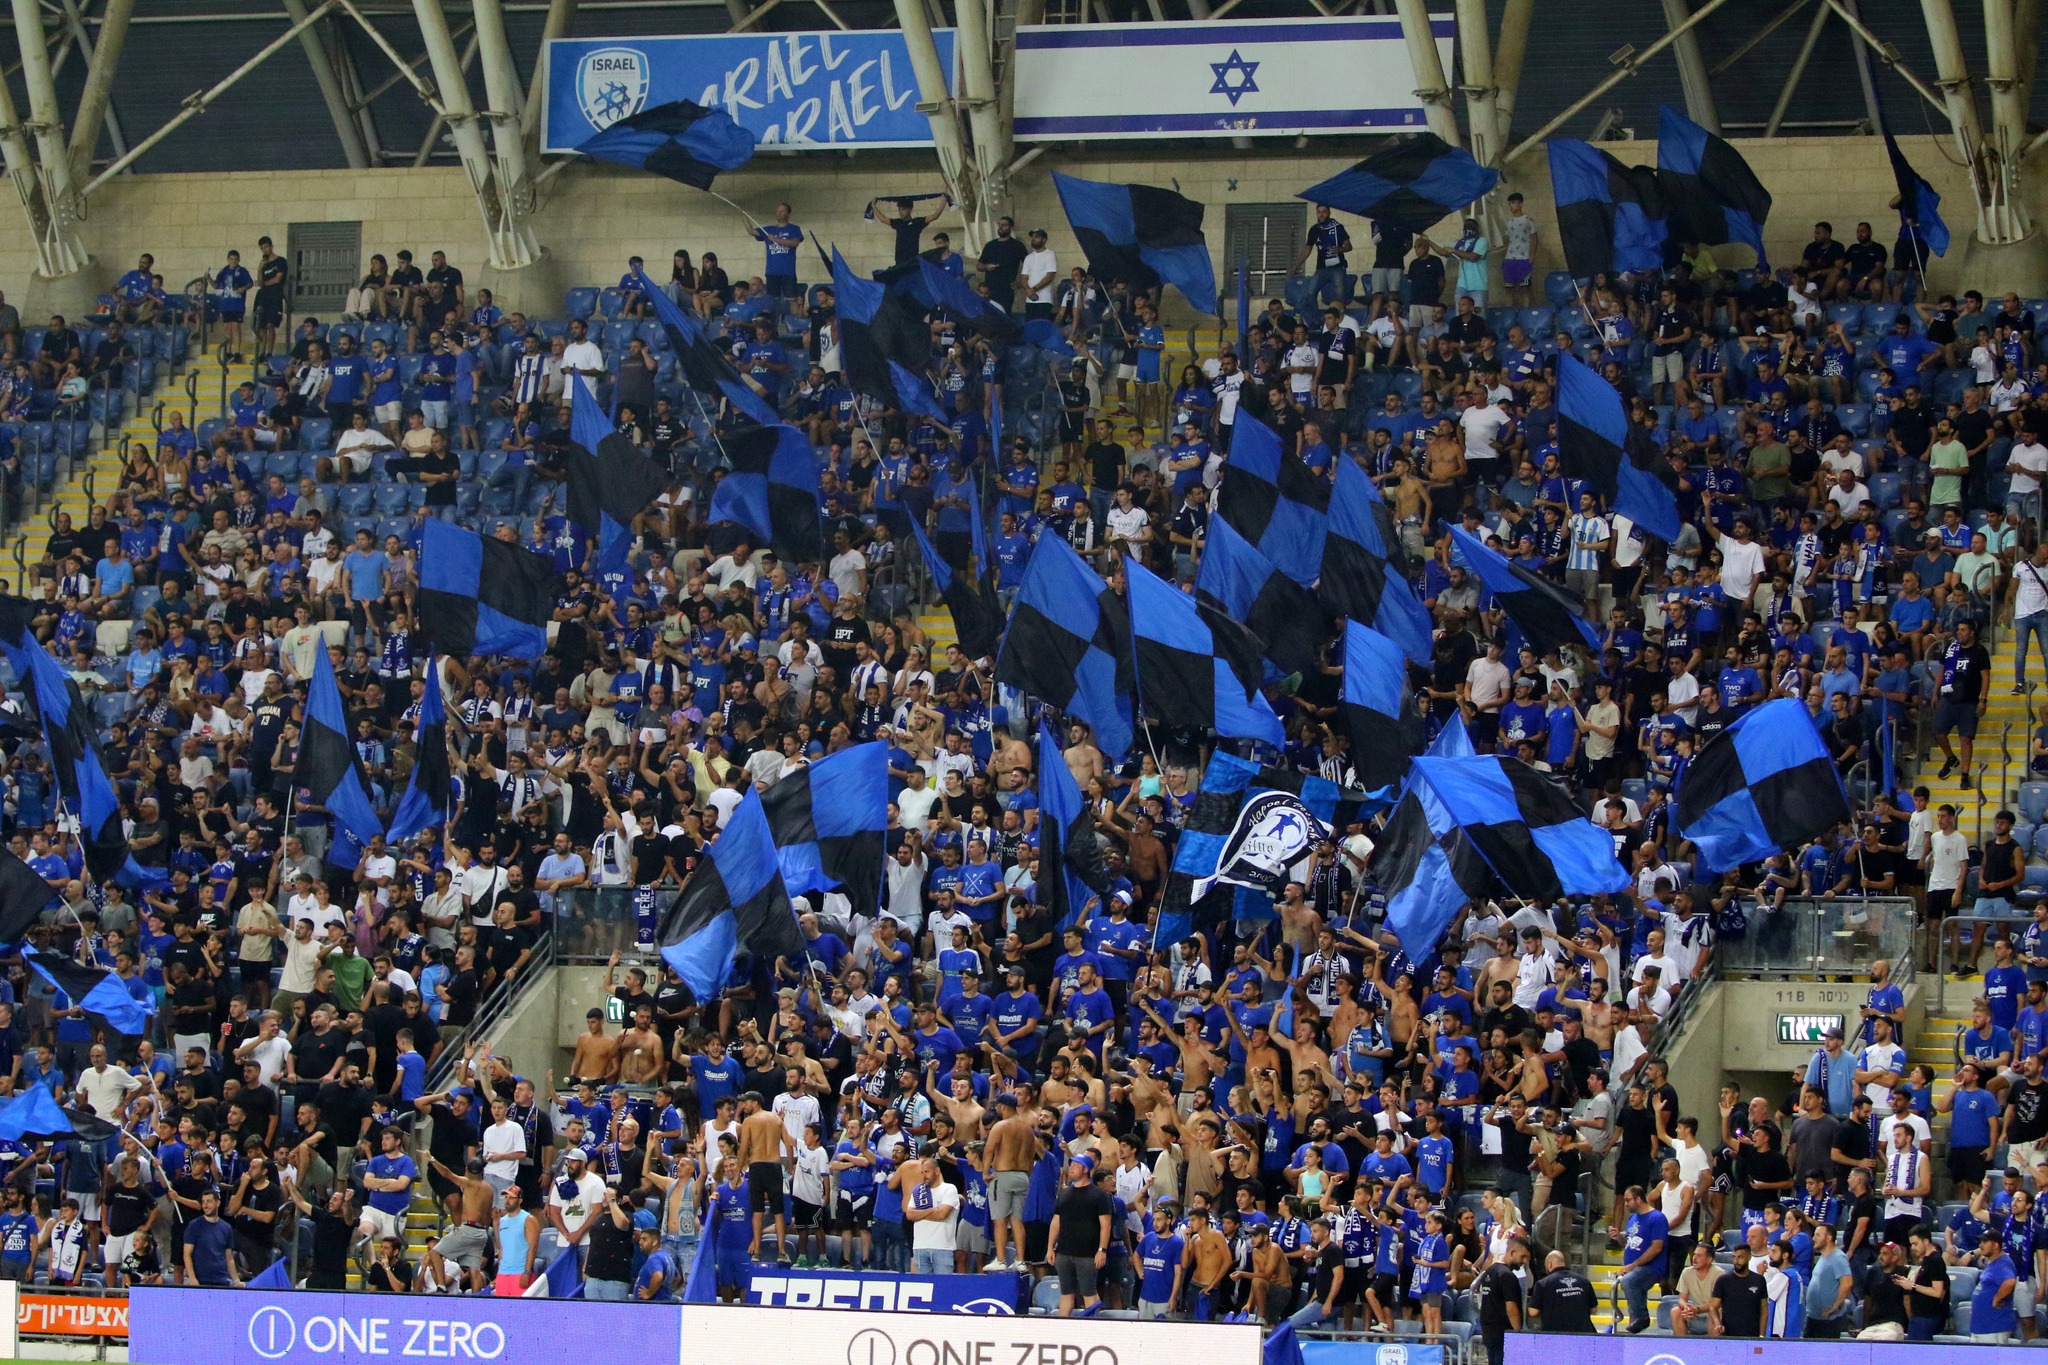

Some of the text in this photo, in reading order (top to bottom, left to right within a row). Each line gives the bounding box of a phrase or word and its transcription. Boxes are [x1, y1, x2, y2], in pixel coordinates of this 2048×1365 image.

[592, 57, 635, 71] ISRAEL
[698, 35, 850, 126] RAEL
[761, 49, 913, 144] RAEL
[335, 366, 352, 375] HPT
[835, 628, 853, 640] HPT
[1956, 660, 1970, 670] PT
[257, 705, 280, 718] INDIANA
[261, 715, 270, 725] 13
[201, 913, 215, 921] NIKE
[1776, 990, 1805, 1002] 11B
[1818, 989, 1849, 1002] כניסה
[1782, 1017, 1838, 1041] יציאה
[303, 1315, 506, 1359] ONE ZERO
[906, 1338, 1119, 1365] ONE ZERO
